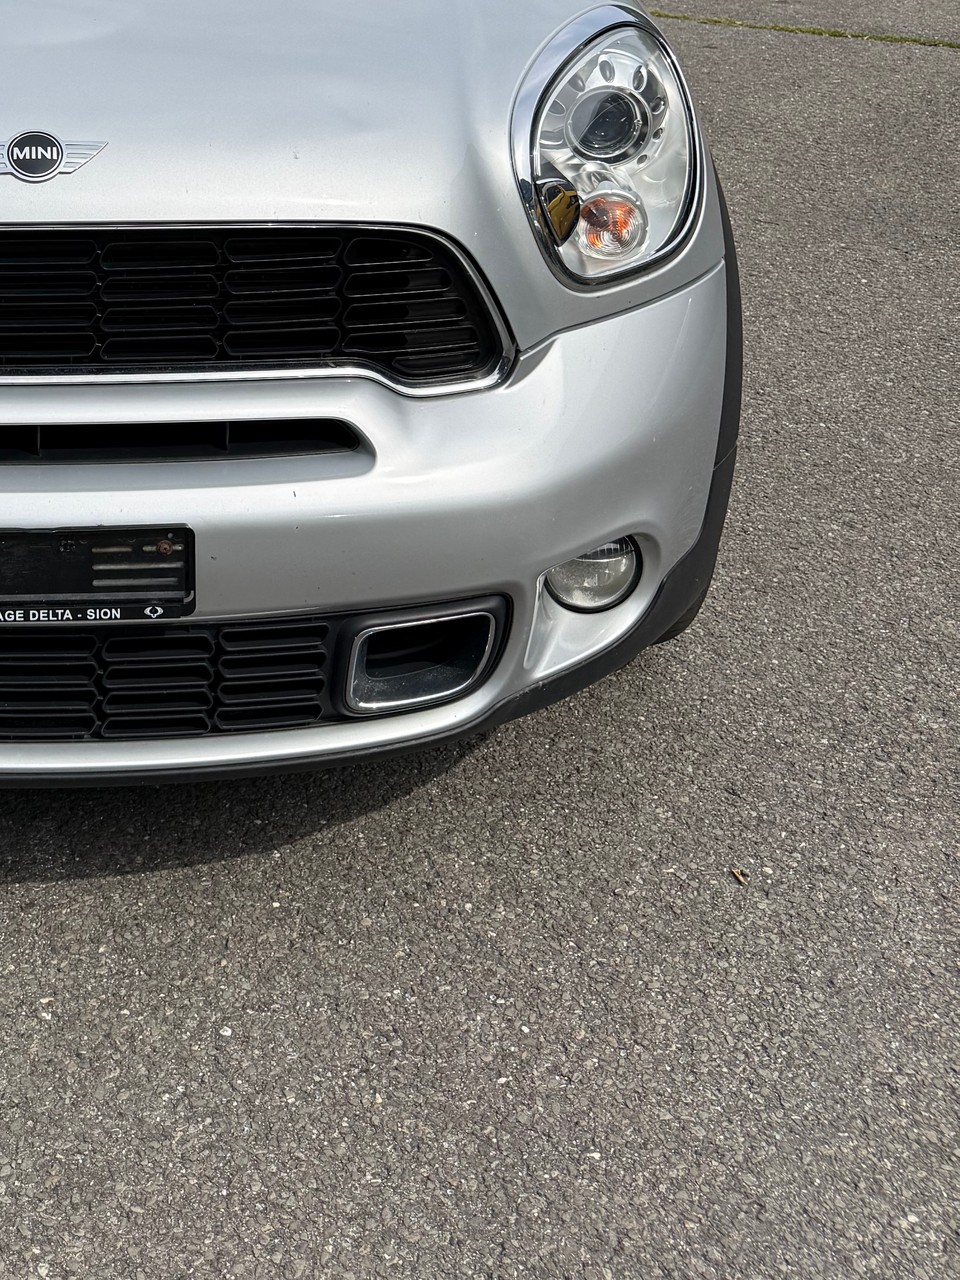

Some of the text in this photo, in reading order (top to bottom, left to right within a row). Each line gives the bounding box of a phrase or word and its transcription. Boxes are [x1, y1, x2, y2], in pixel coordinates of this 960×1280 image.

[13, 146, 57, 160] MINI
[29, 609, 73, 621] DELTA
[86, 608, 121, 620] SION
